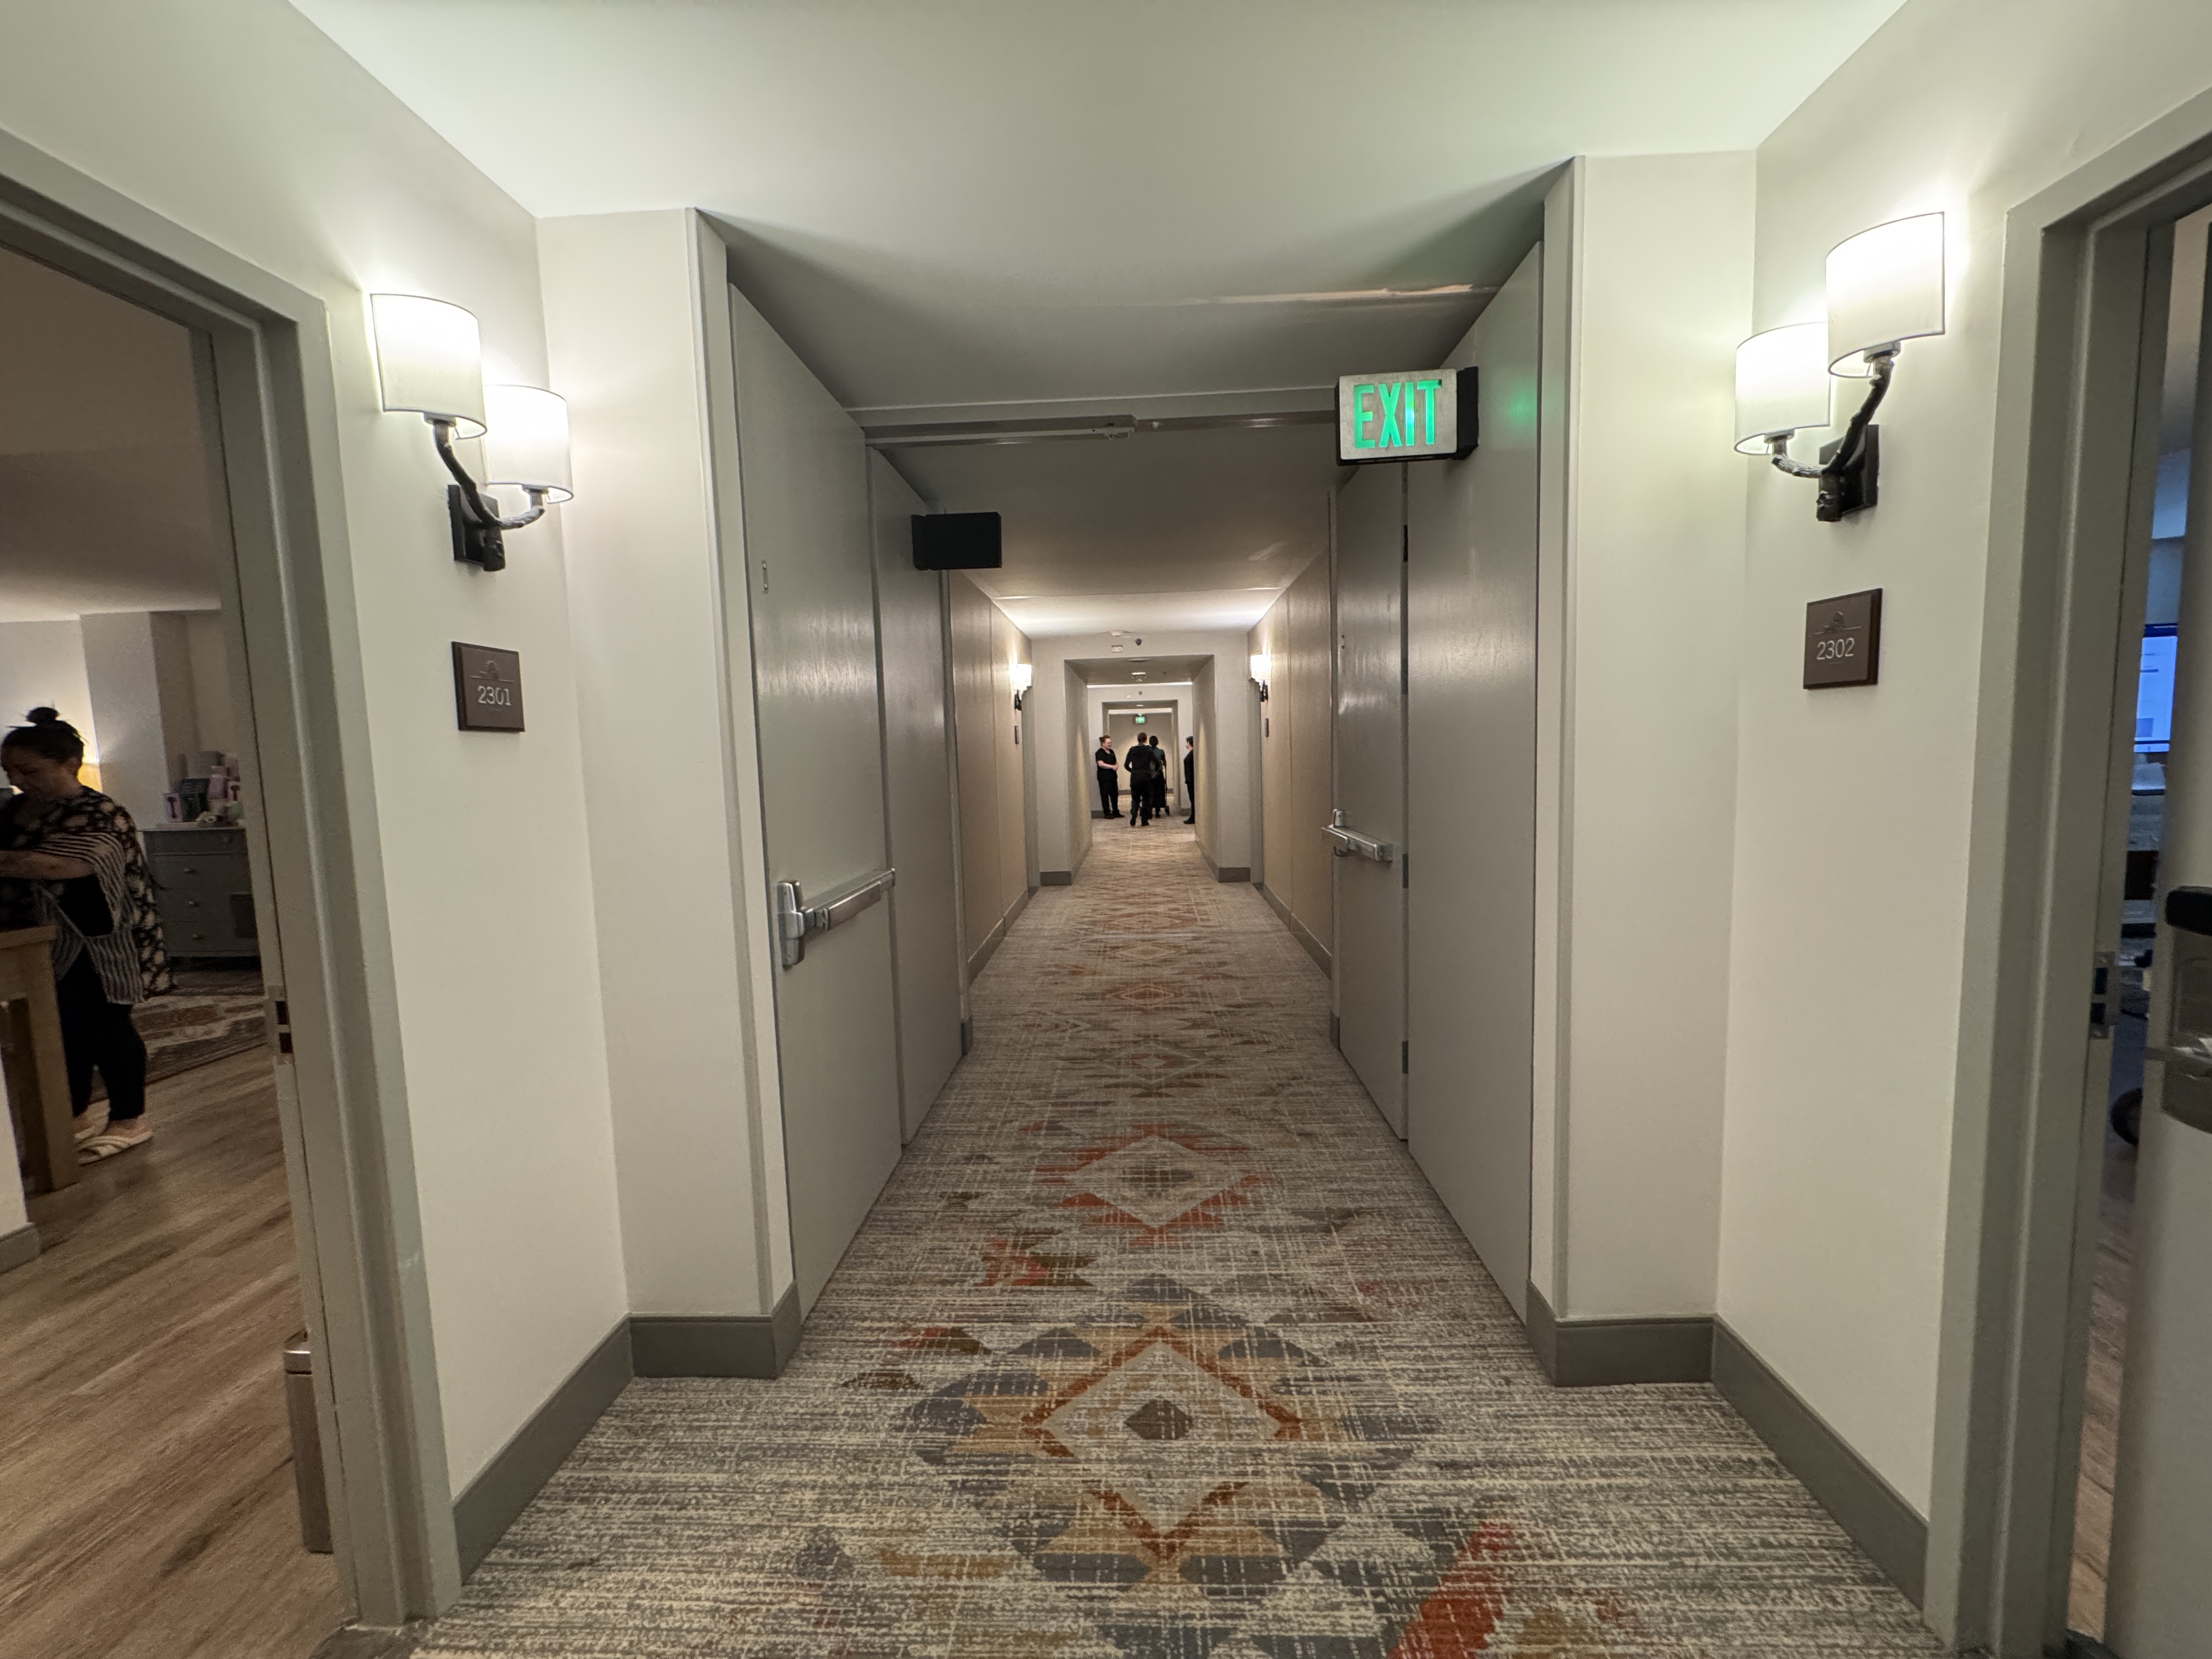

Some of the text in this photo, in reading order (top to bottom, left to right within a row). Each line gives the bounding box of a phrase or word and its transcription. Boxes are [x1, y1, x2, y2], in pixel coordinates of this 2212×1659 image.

[1353, 379, 1442, 449] EXIT
[1816, 637, 1854, 660] 2302
[477, 685, 512, 706] 2301
